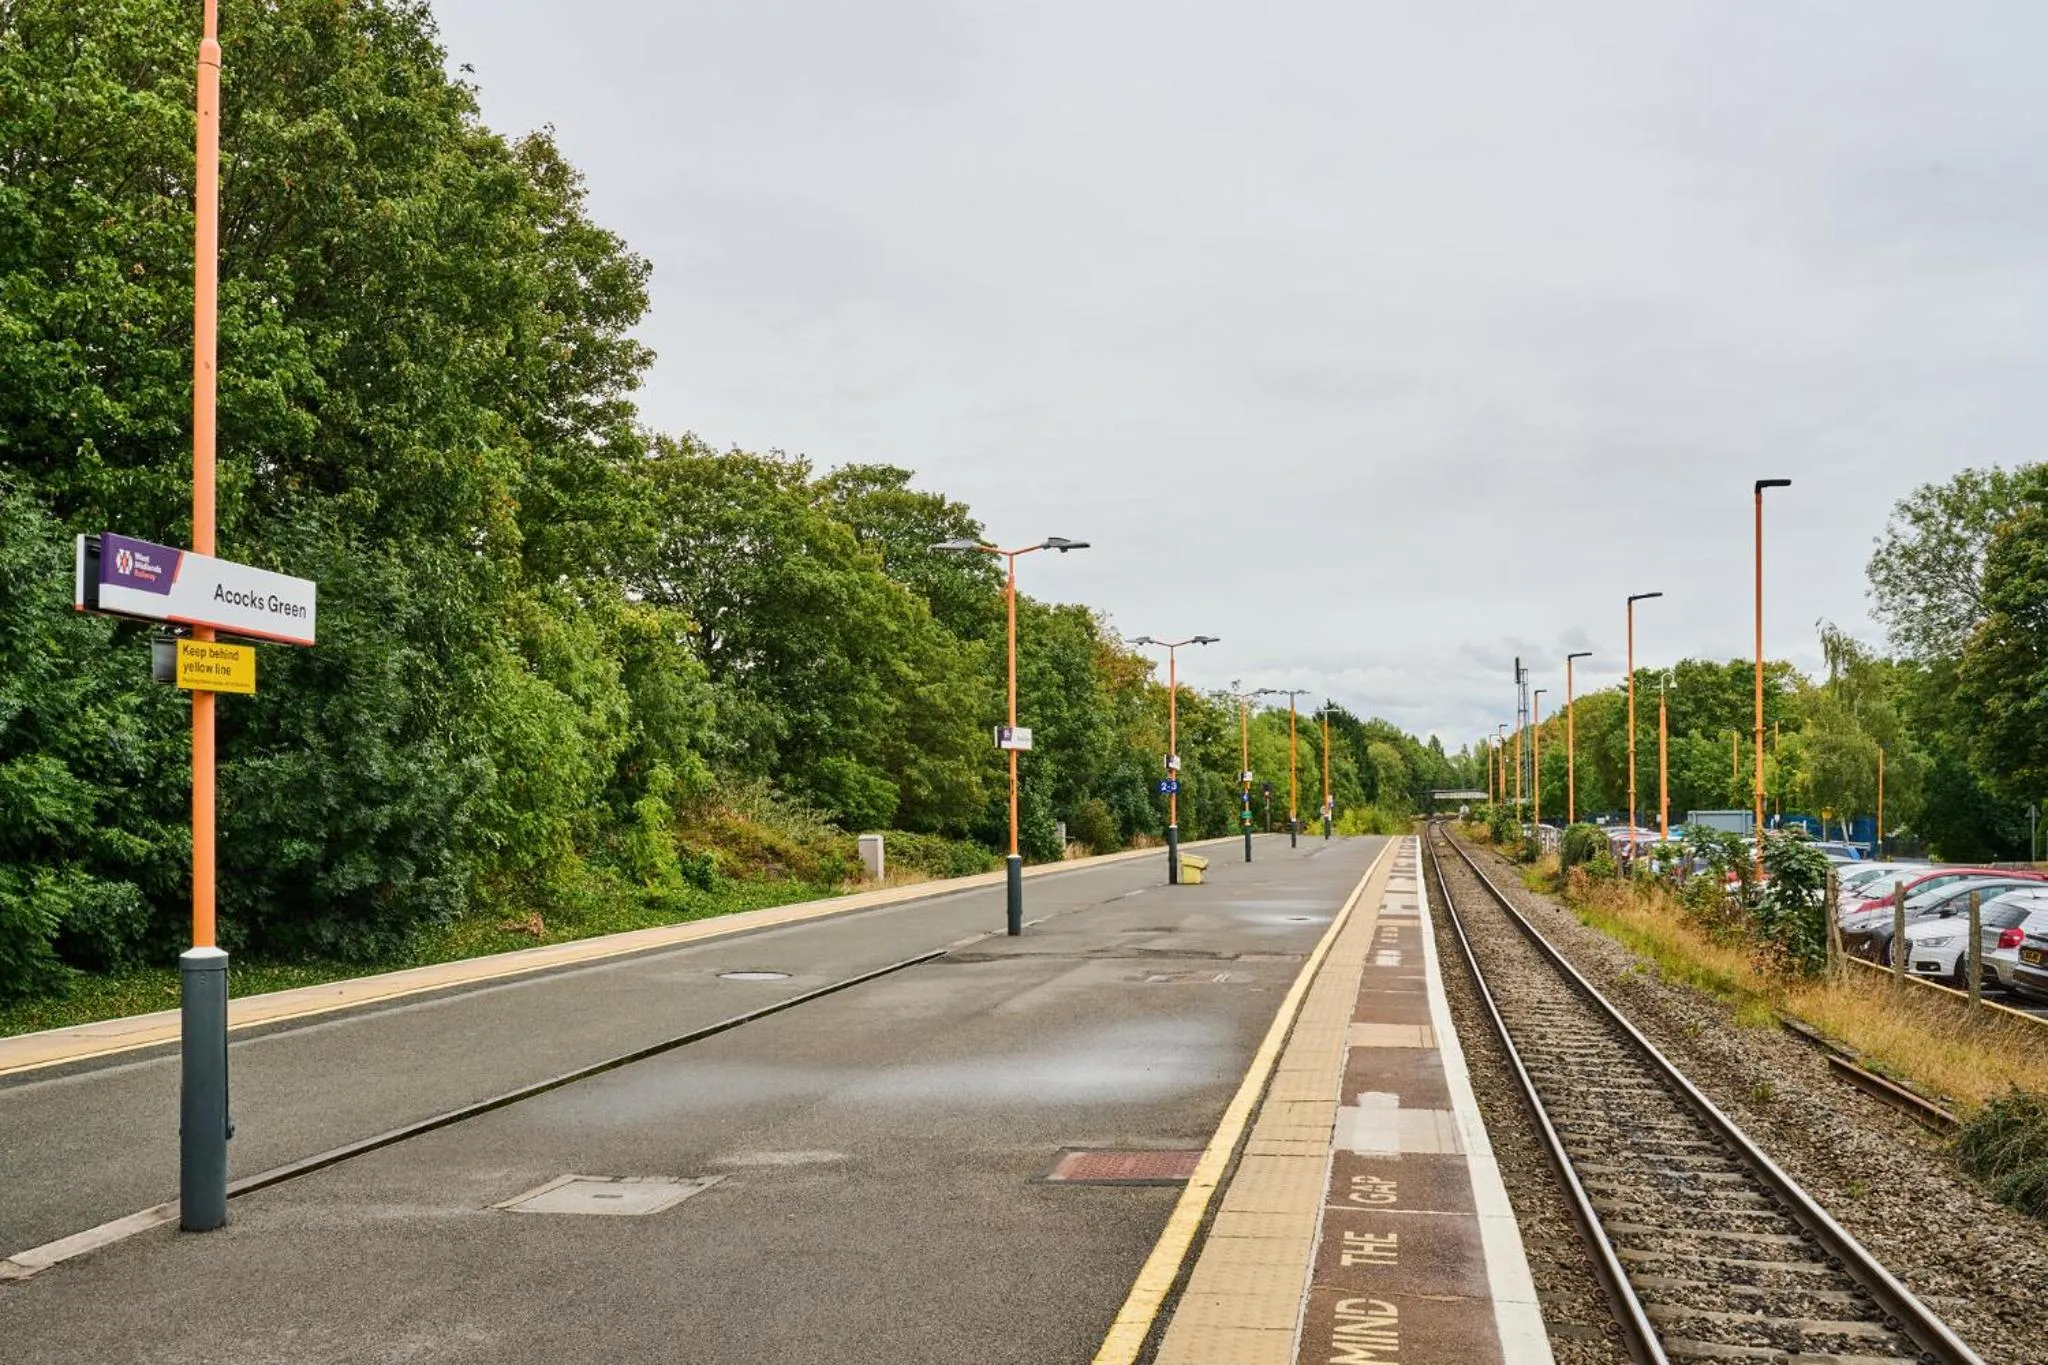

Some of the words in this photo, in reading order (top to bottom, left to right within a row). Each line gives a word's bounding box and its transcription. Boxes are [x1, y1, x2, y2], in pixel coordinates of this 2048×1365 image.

[214, 583, 264, 610] Acocks
[268, 595, 307, 619] Green
[183, 645, 207, 659] Keep
[209, 647, 240, 661] behind
[184, 661, 213, 675] yellow
[215, 664, 232, 676] line
[1349, 1175, 1398, 1205] GAP
[1341, 1231, 1398, 1266] THE
[1329, 1298, 1400, 1365] MIND
